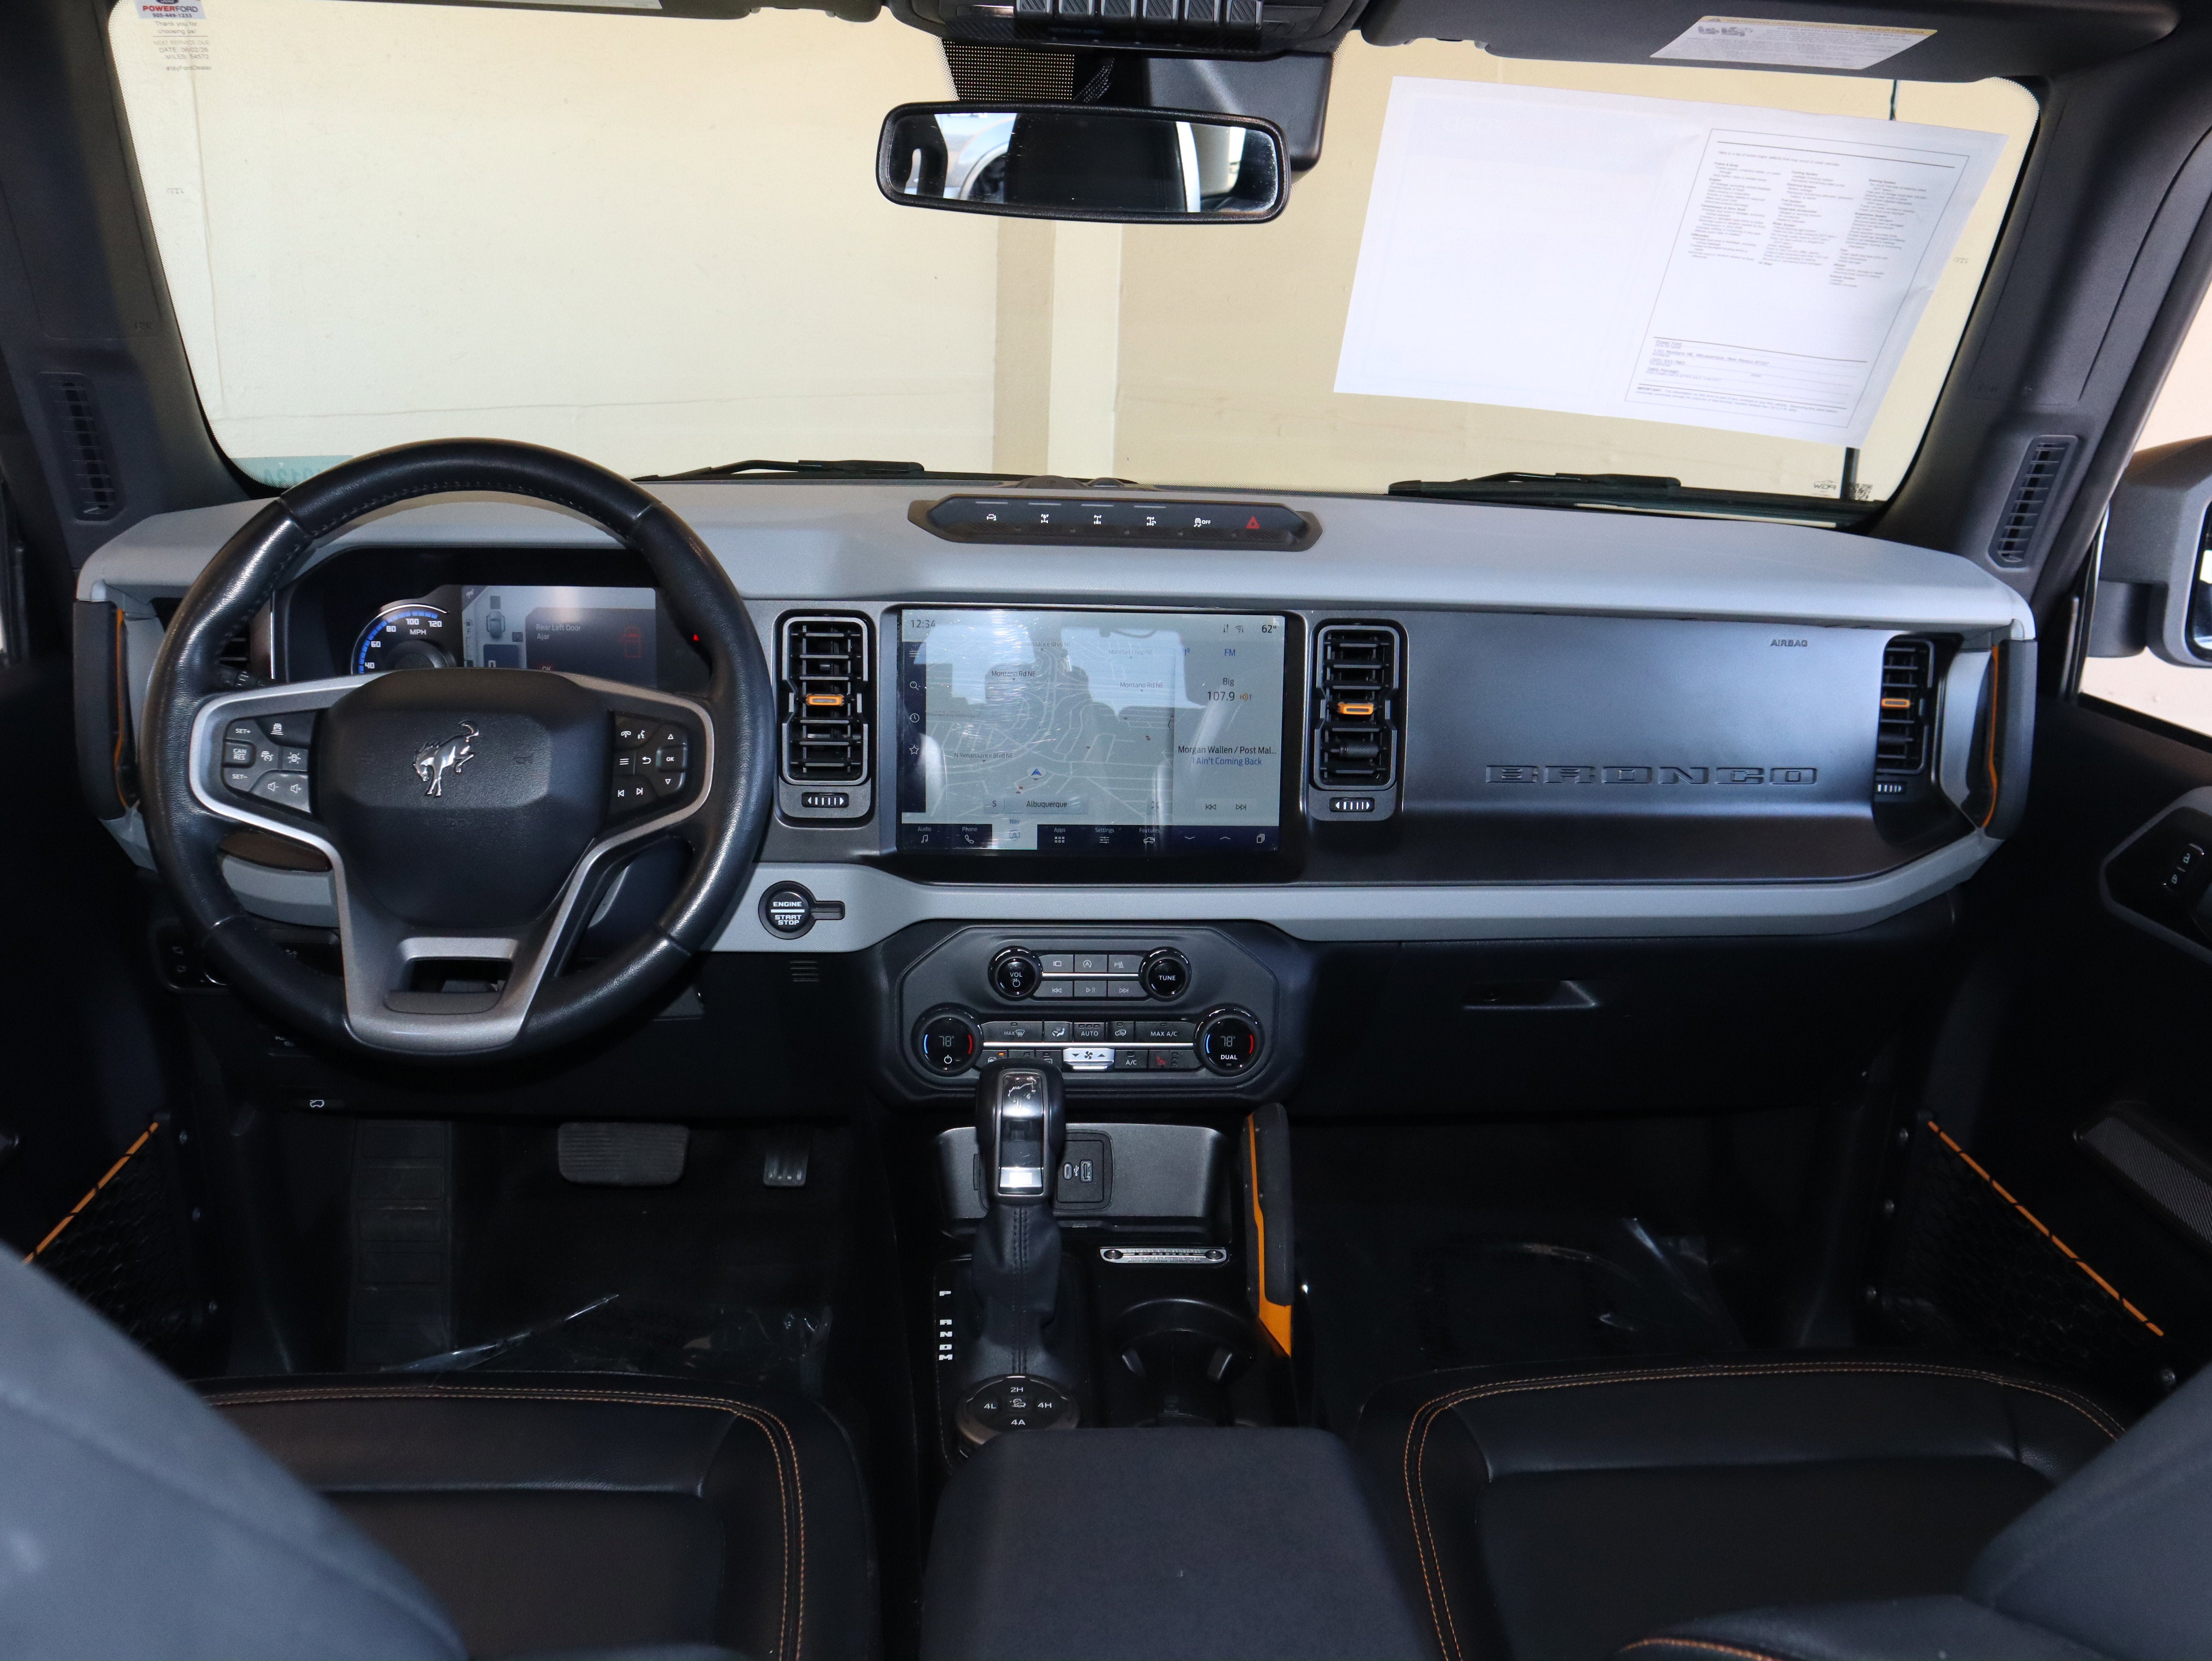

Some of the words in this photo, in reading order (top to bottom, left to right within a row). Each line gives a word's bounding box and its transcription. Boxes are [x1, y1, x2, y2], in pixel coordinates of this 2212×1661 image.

[910, 620, 936, 628] 12:34
[1261, 625, 1277, 633] 62°
[1223, 677, 1235, 687] Big
[1207, 691, 1235, 701] 107.9
[1178, 746, 1206, 755] Morgan
[1215, 757, 1243, 766] Coming
[1486, 765, 1818, 785] BRONCO
[1026, 800, 1067, 808] Albuquerque
